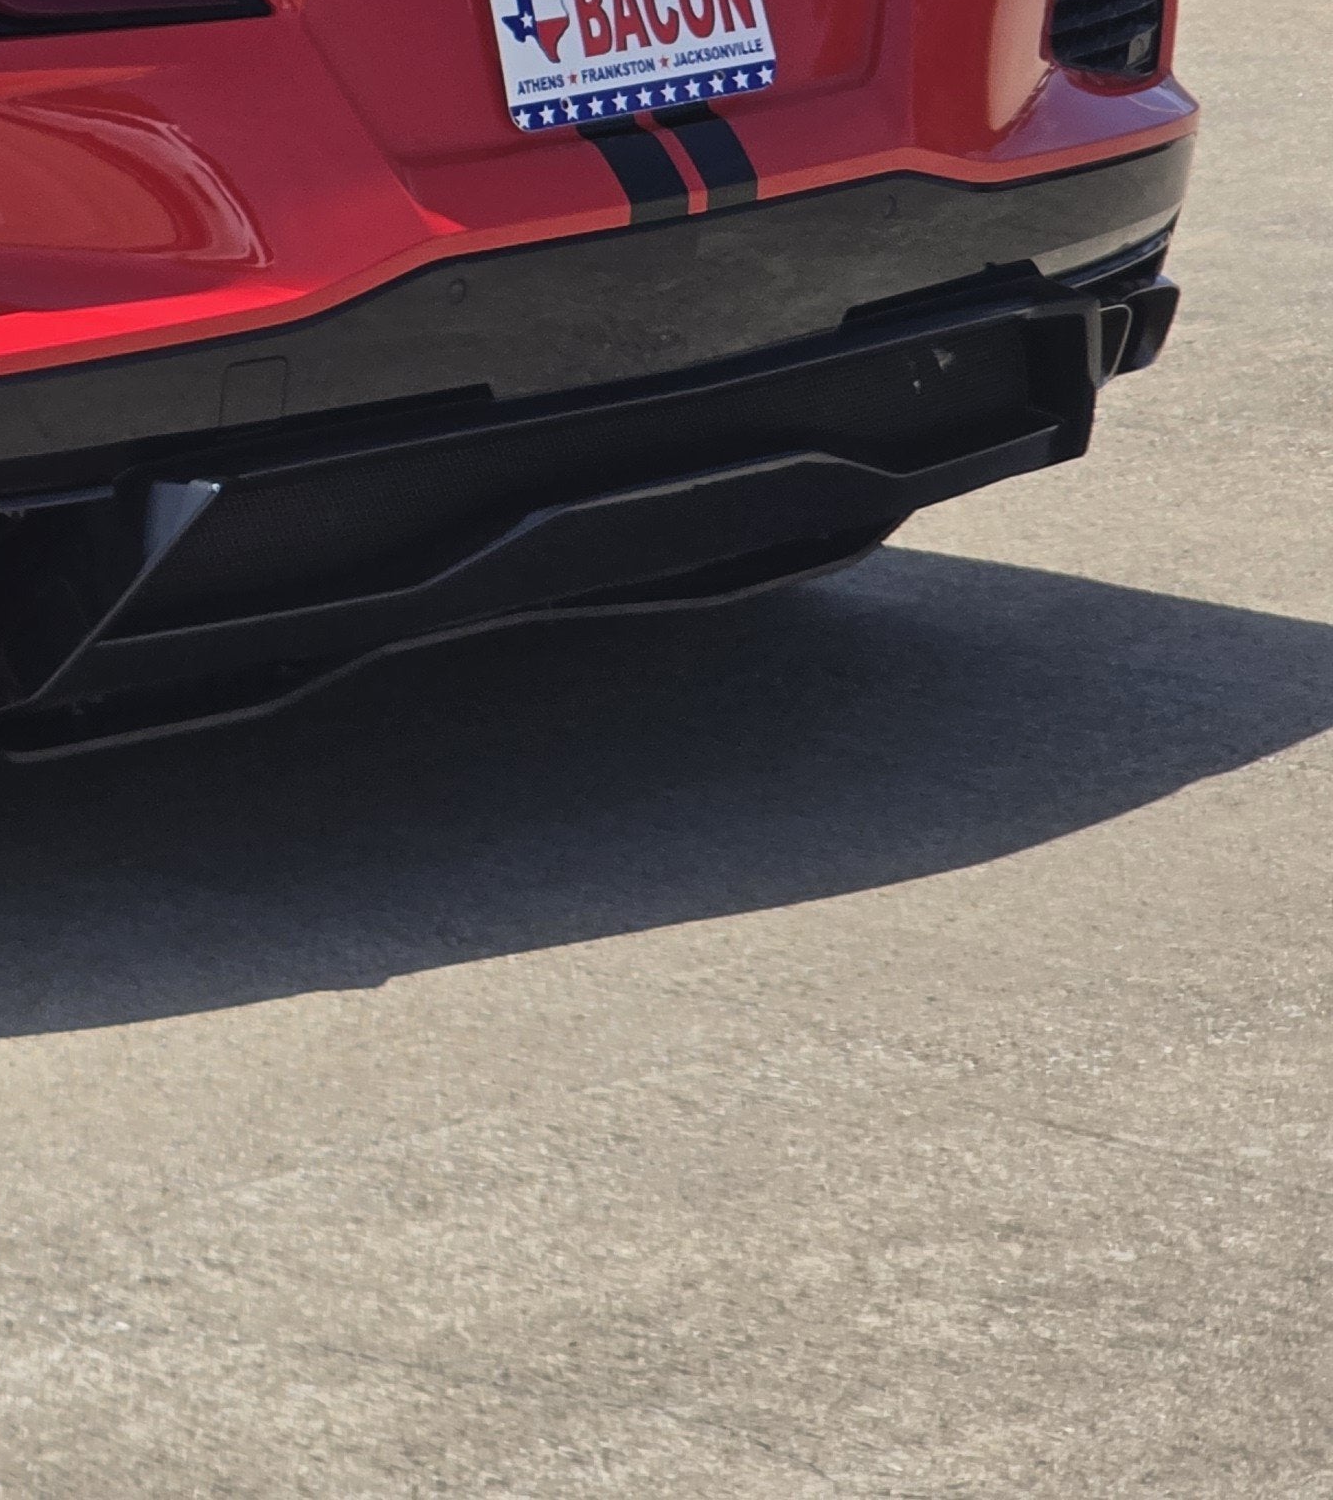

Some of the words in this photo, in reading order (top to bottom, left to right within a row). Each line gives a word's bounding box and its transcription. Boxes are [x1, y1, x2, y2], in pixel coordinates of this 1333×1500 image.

[517, 73, 565, 96] ATHENS
[580, 56, 656, 85] FRANKSTON
[672, 37, 765, 68] JACKSONVILLE
